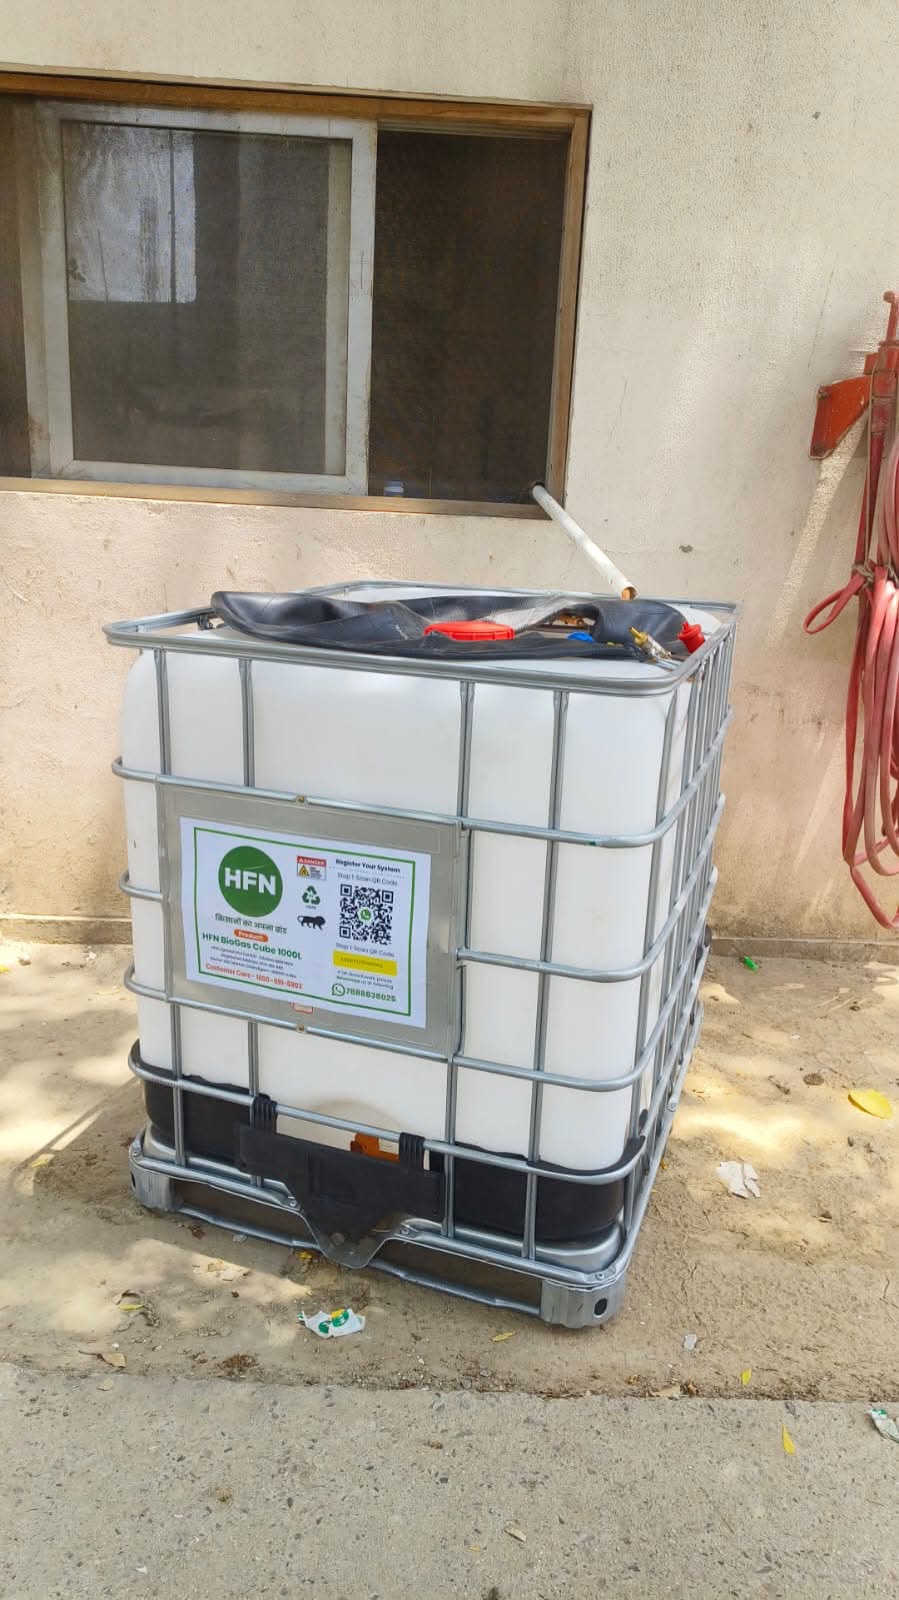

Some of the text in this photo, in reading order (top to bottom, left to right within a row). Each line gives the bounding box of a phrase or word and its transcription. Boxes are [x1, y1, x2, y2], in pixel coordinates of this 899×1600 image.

[336, 858, 401, 873] Register Your System
[225, 867, 276, 896] HFN
[373, 876, 381, 884] QR
[382, 878, 398, 886] Code
[242, 919, 253, 928] का
[254, 921, 274, 932] अपना
[202, 932, 220, 942] HFN
[220, 936, 248, 949] BioGas
[252, 943, 276, 955] Cube
[278, 947, 303, 960] 1000L
